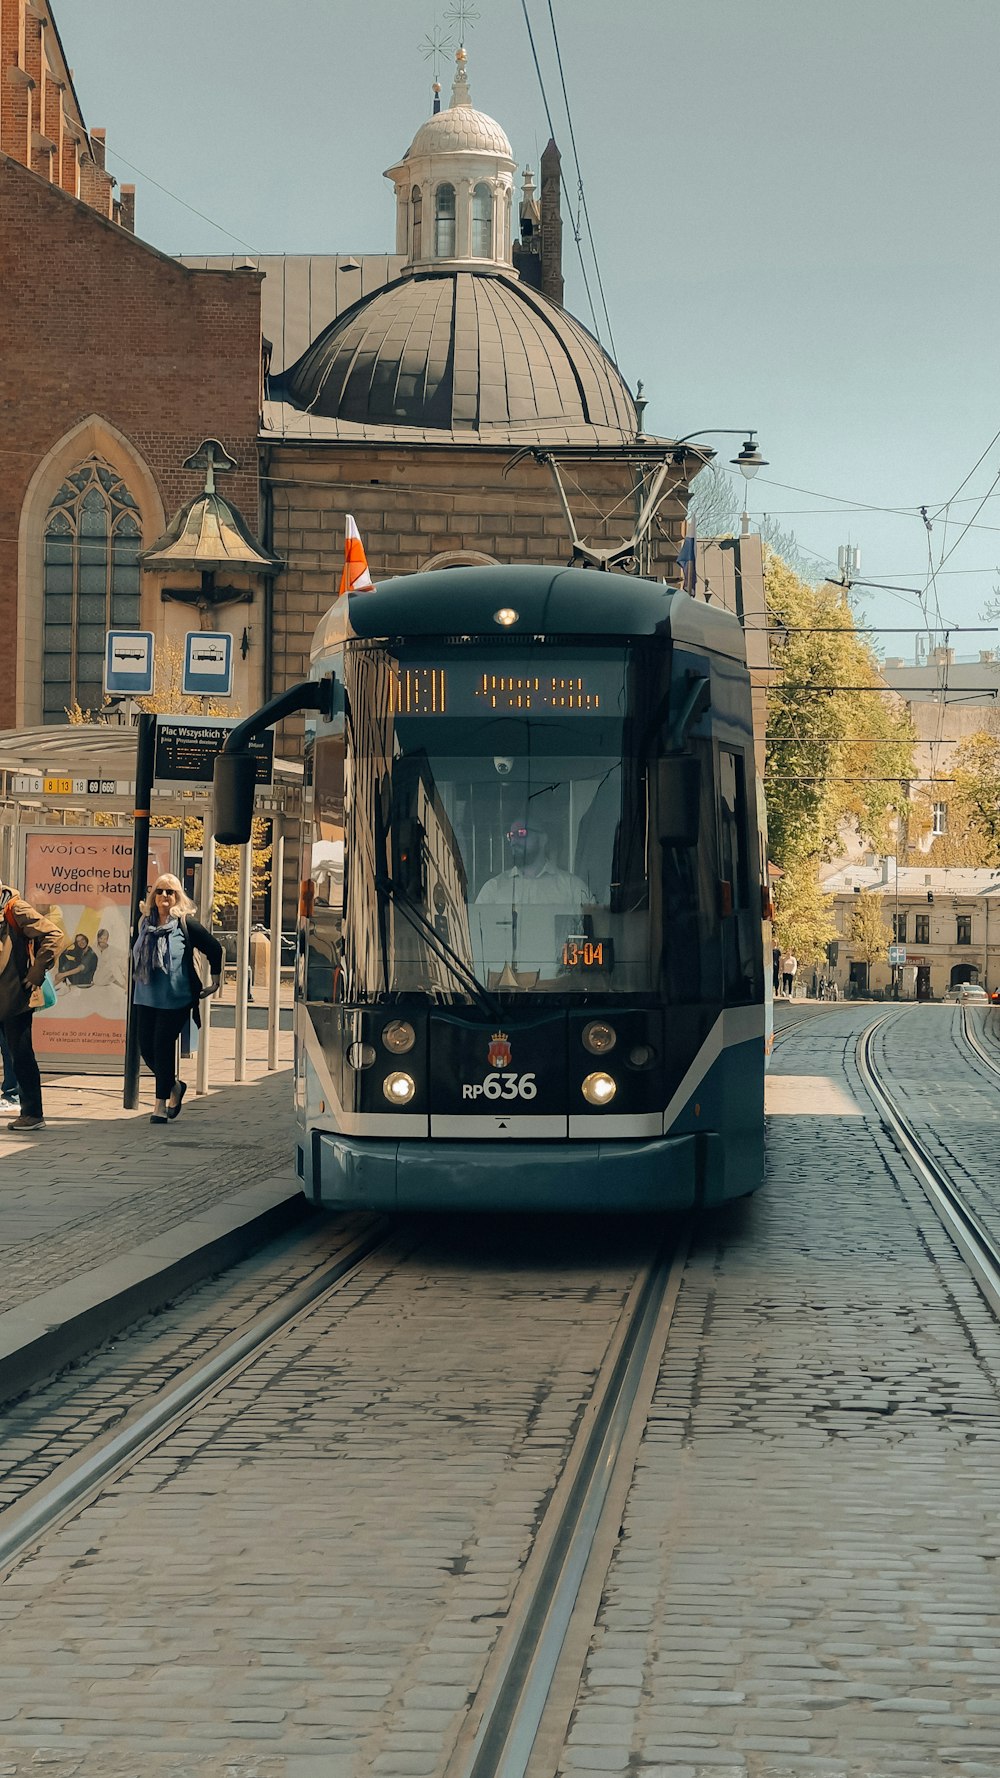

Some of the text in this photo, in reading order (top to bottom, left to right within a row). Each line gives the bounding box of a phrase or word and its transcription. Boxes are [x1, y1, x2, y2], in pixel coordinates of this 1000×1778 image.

[161, 726, 177, 736] Plac
[178, 727, 220, 739] Wszystkich
[34, 781, 39, 790] 6
[48, 781, 53, 790] 8
[61, 781, 69, 791] 13
[76, 781, 84, 791] 18
[89, 781, 99, 793] 69
[101, 781, 115, 793] 669
[40, 841, 98, 856] wojas
[112, 845, 133, 856] Kla
[51, 866, 111, 880] Wygodne
[35, 881, 95, 895] wygodne
[462, 1072, 538, 1100] RP636
